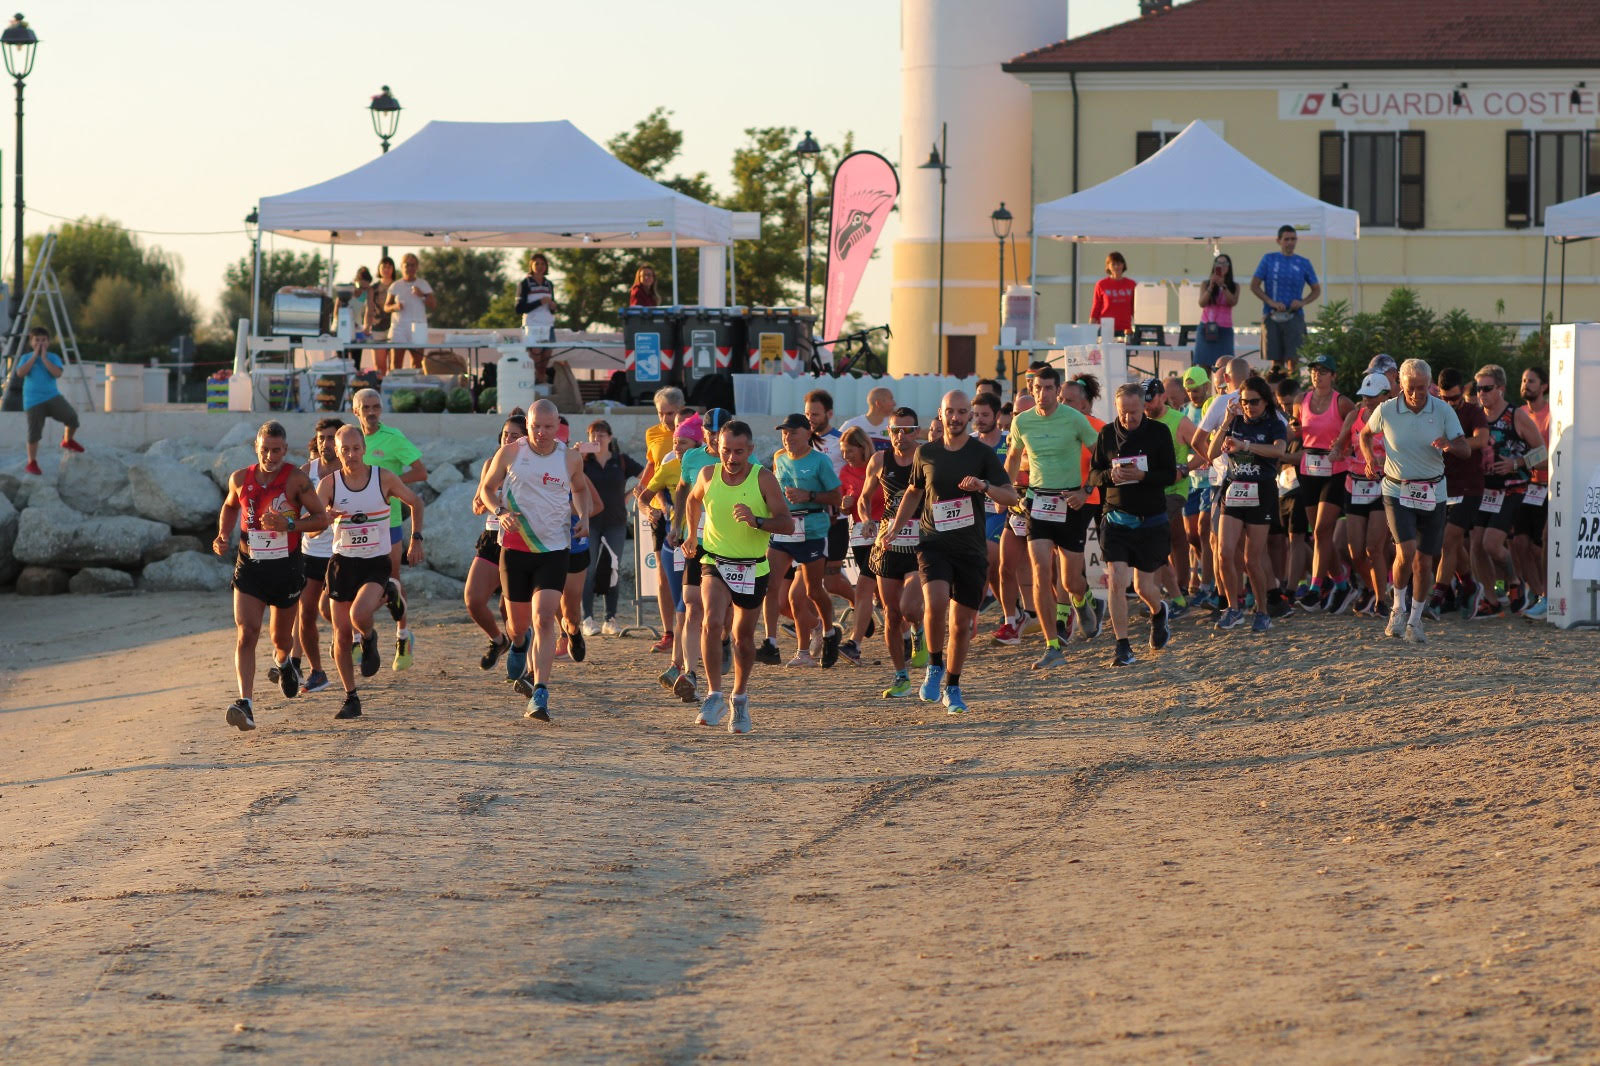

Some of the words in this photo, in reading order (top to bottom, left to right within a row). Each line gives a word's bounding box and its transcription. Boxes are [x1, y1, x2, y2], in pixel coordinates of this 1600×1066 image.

[1339, 93, 1473, 115] GUARDIA
[1484, 93, 1600, 115] COSTIE
[1410, 491, 1427, 499] 284
[946, 510, 960, 519] 217
[265, 540, 271, 548] 7
[351, 536, 369, 544] 220
[726, 573, 744, 581] 209
